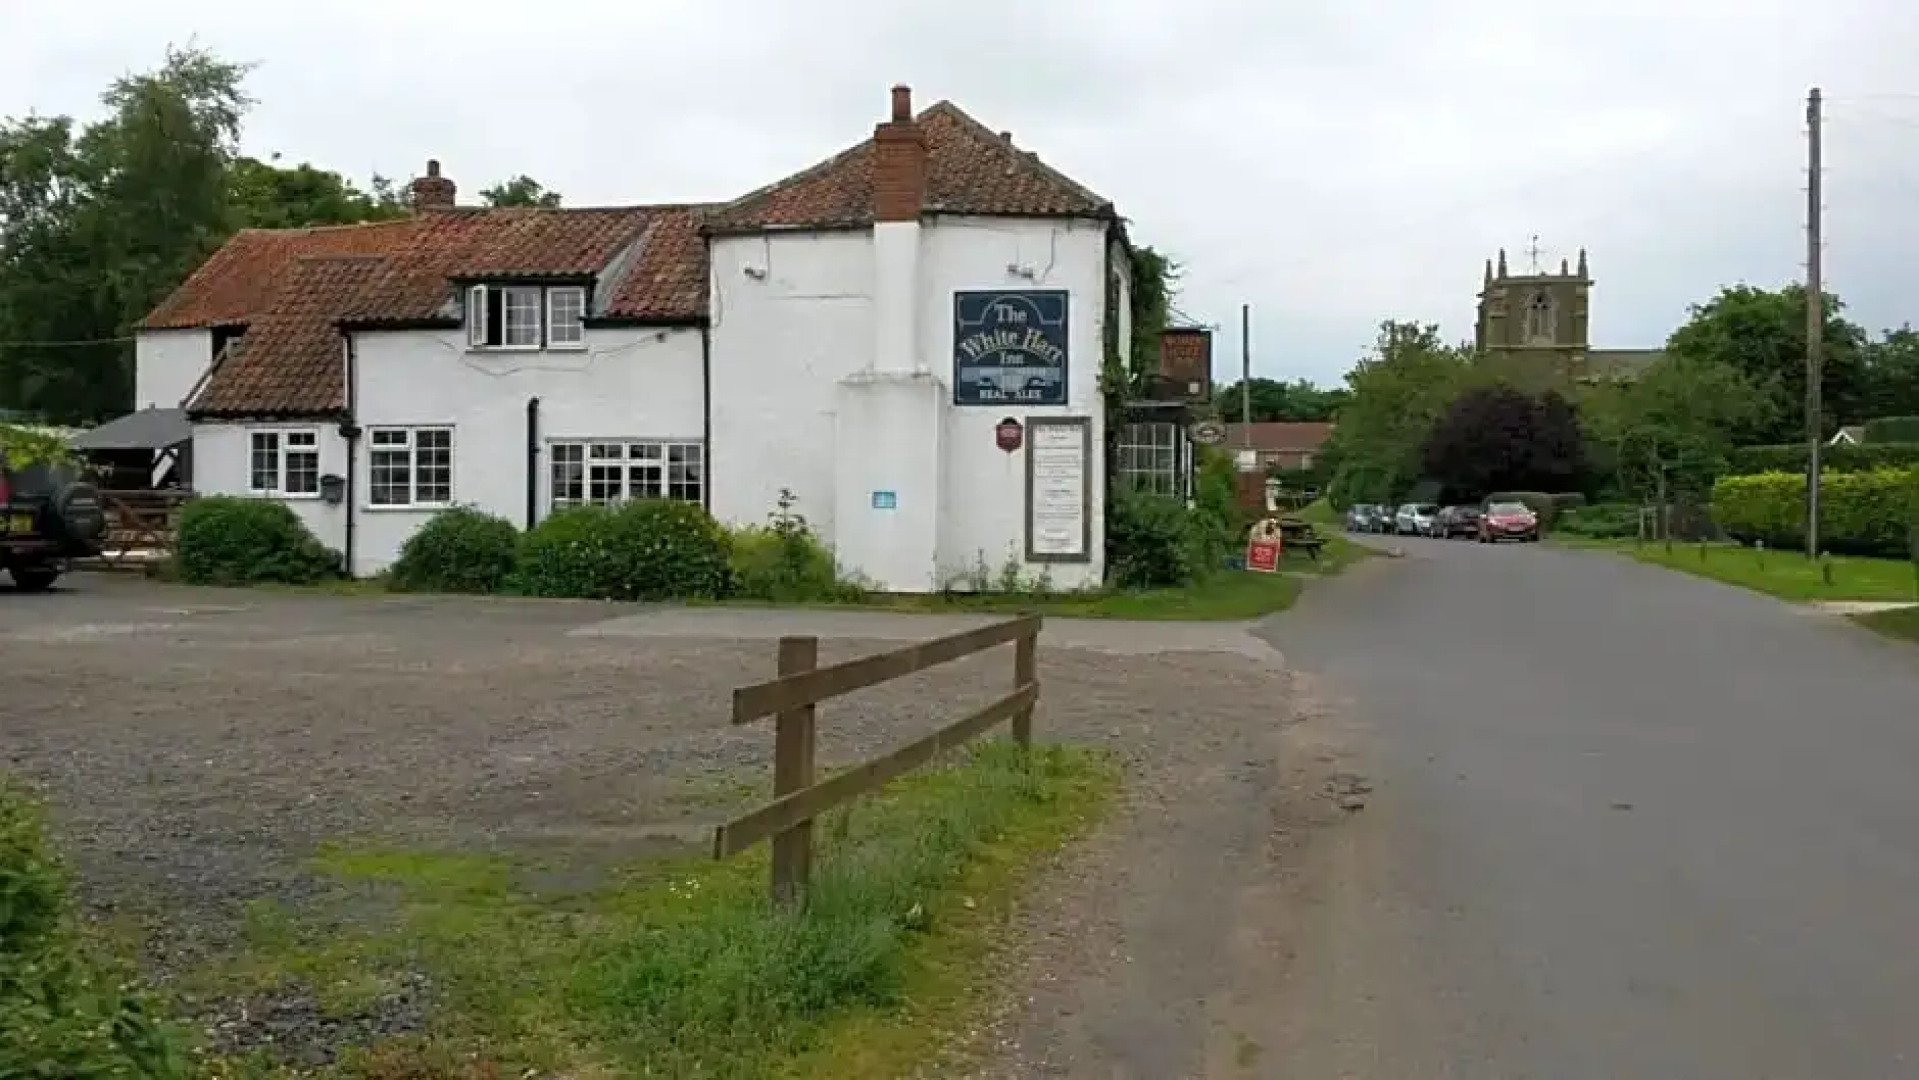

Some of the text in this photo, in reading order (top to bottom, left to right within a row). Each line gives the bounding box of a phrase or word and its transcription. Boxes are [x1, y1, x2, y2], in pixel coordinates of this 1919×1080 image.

[993, 303, 1028, 323] The
[959, 329, 1018, 361] White
[1000, 351, 1024, 365] Inn
